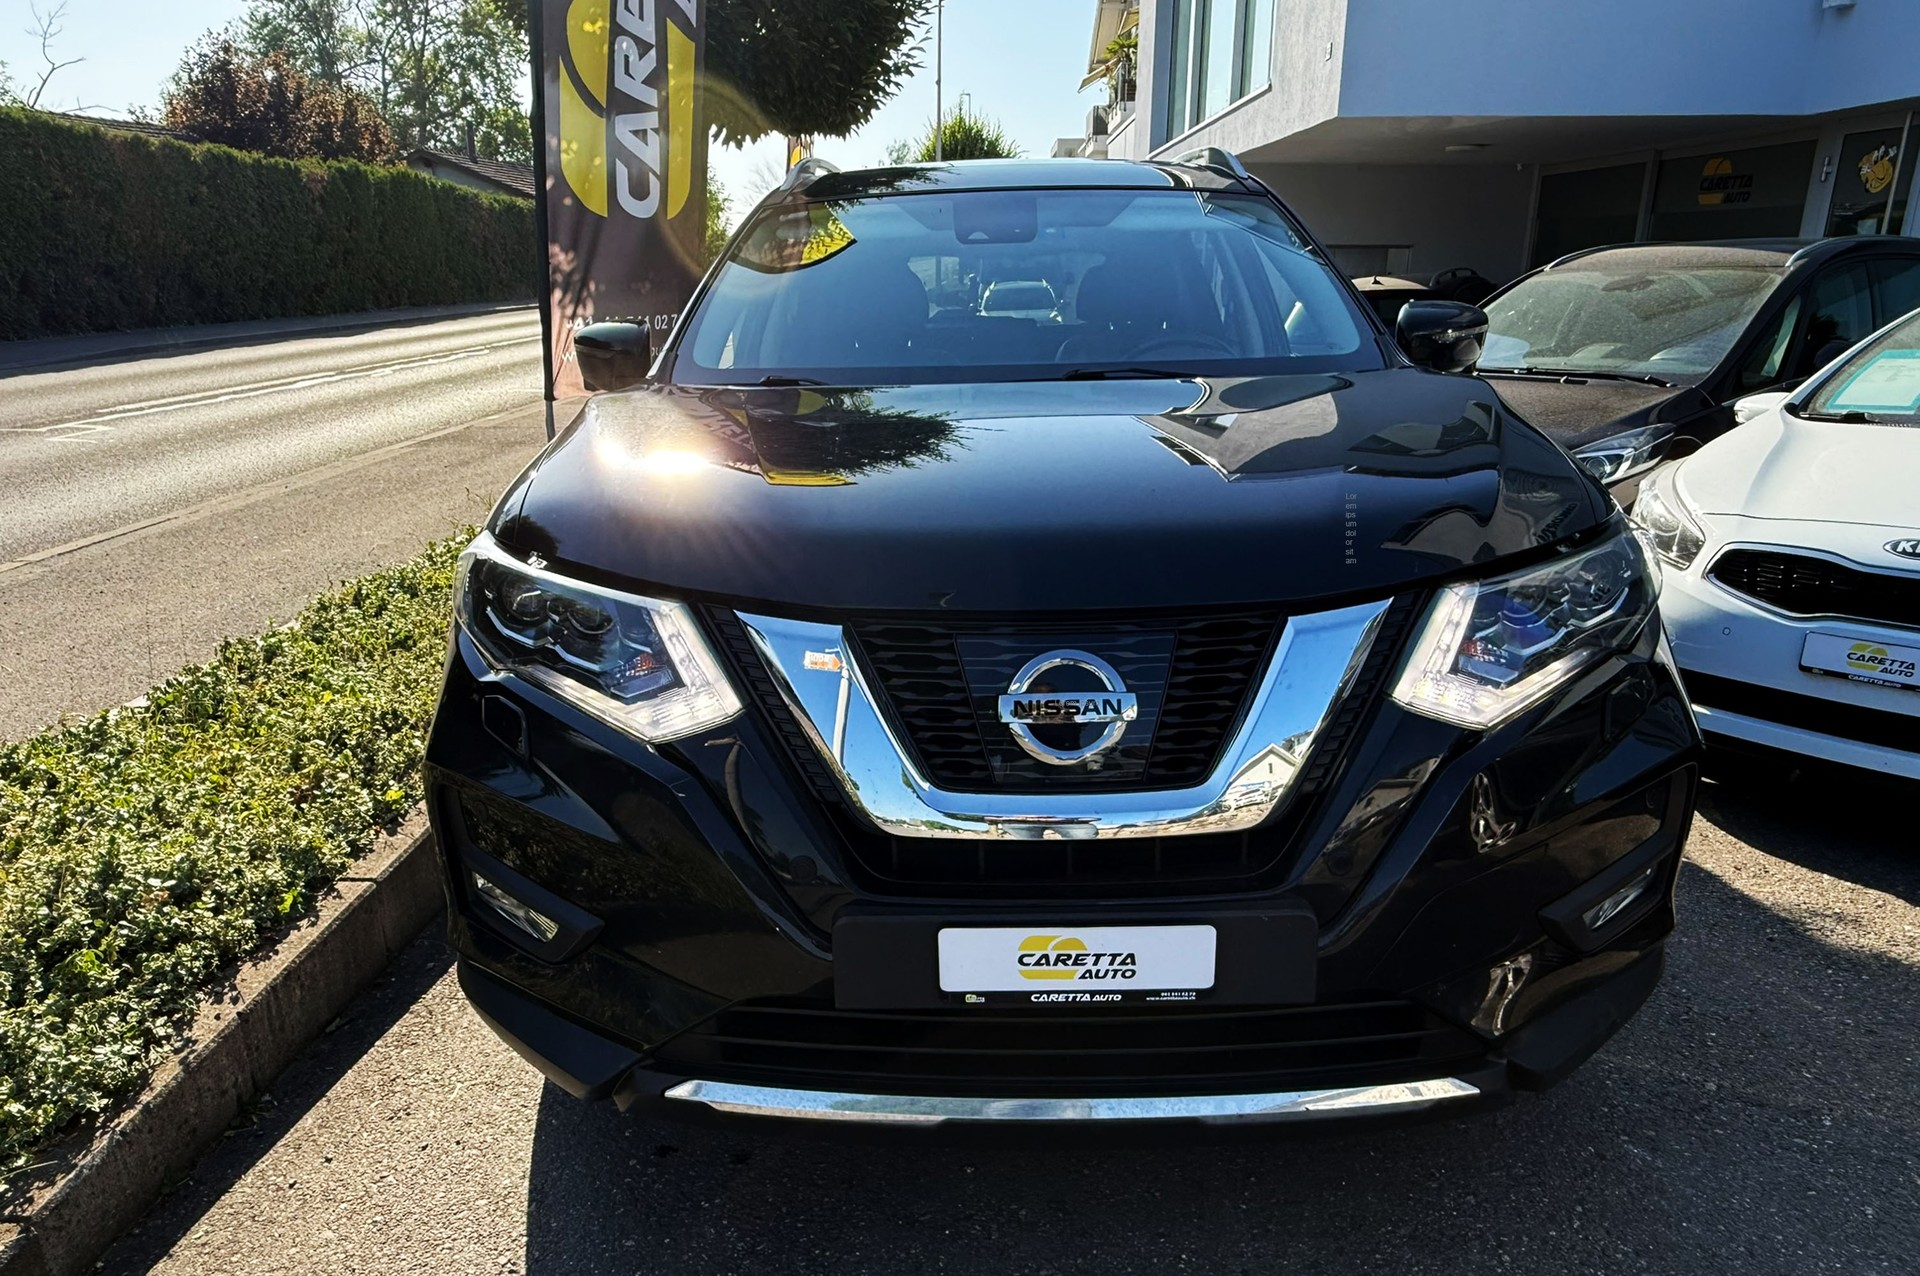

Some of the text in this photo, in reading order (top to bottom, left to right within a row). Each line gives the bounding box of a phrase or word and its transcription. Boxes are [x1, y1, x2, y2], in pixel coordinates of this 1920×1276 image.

[1700, 174, 1753, 191] CARETTA
[1723, 191, 1752, 203] AUTO
[654, 315, 668, 330] 02
[1846, 652, 1915, 670] CARETTA
[1879, 667, 1914, 677] AUTO
[1013, 698, 1122, 717] NISSAN
[1017, 952, 1137, 967] CARETTA
[1078, 968, 1137, 980] AUTO
[1030, 993, 1092, 1002] CARETTA
